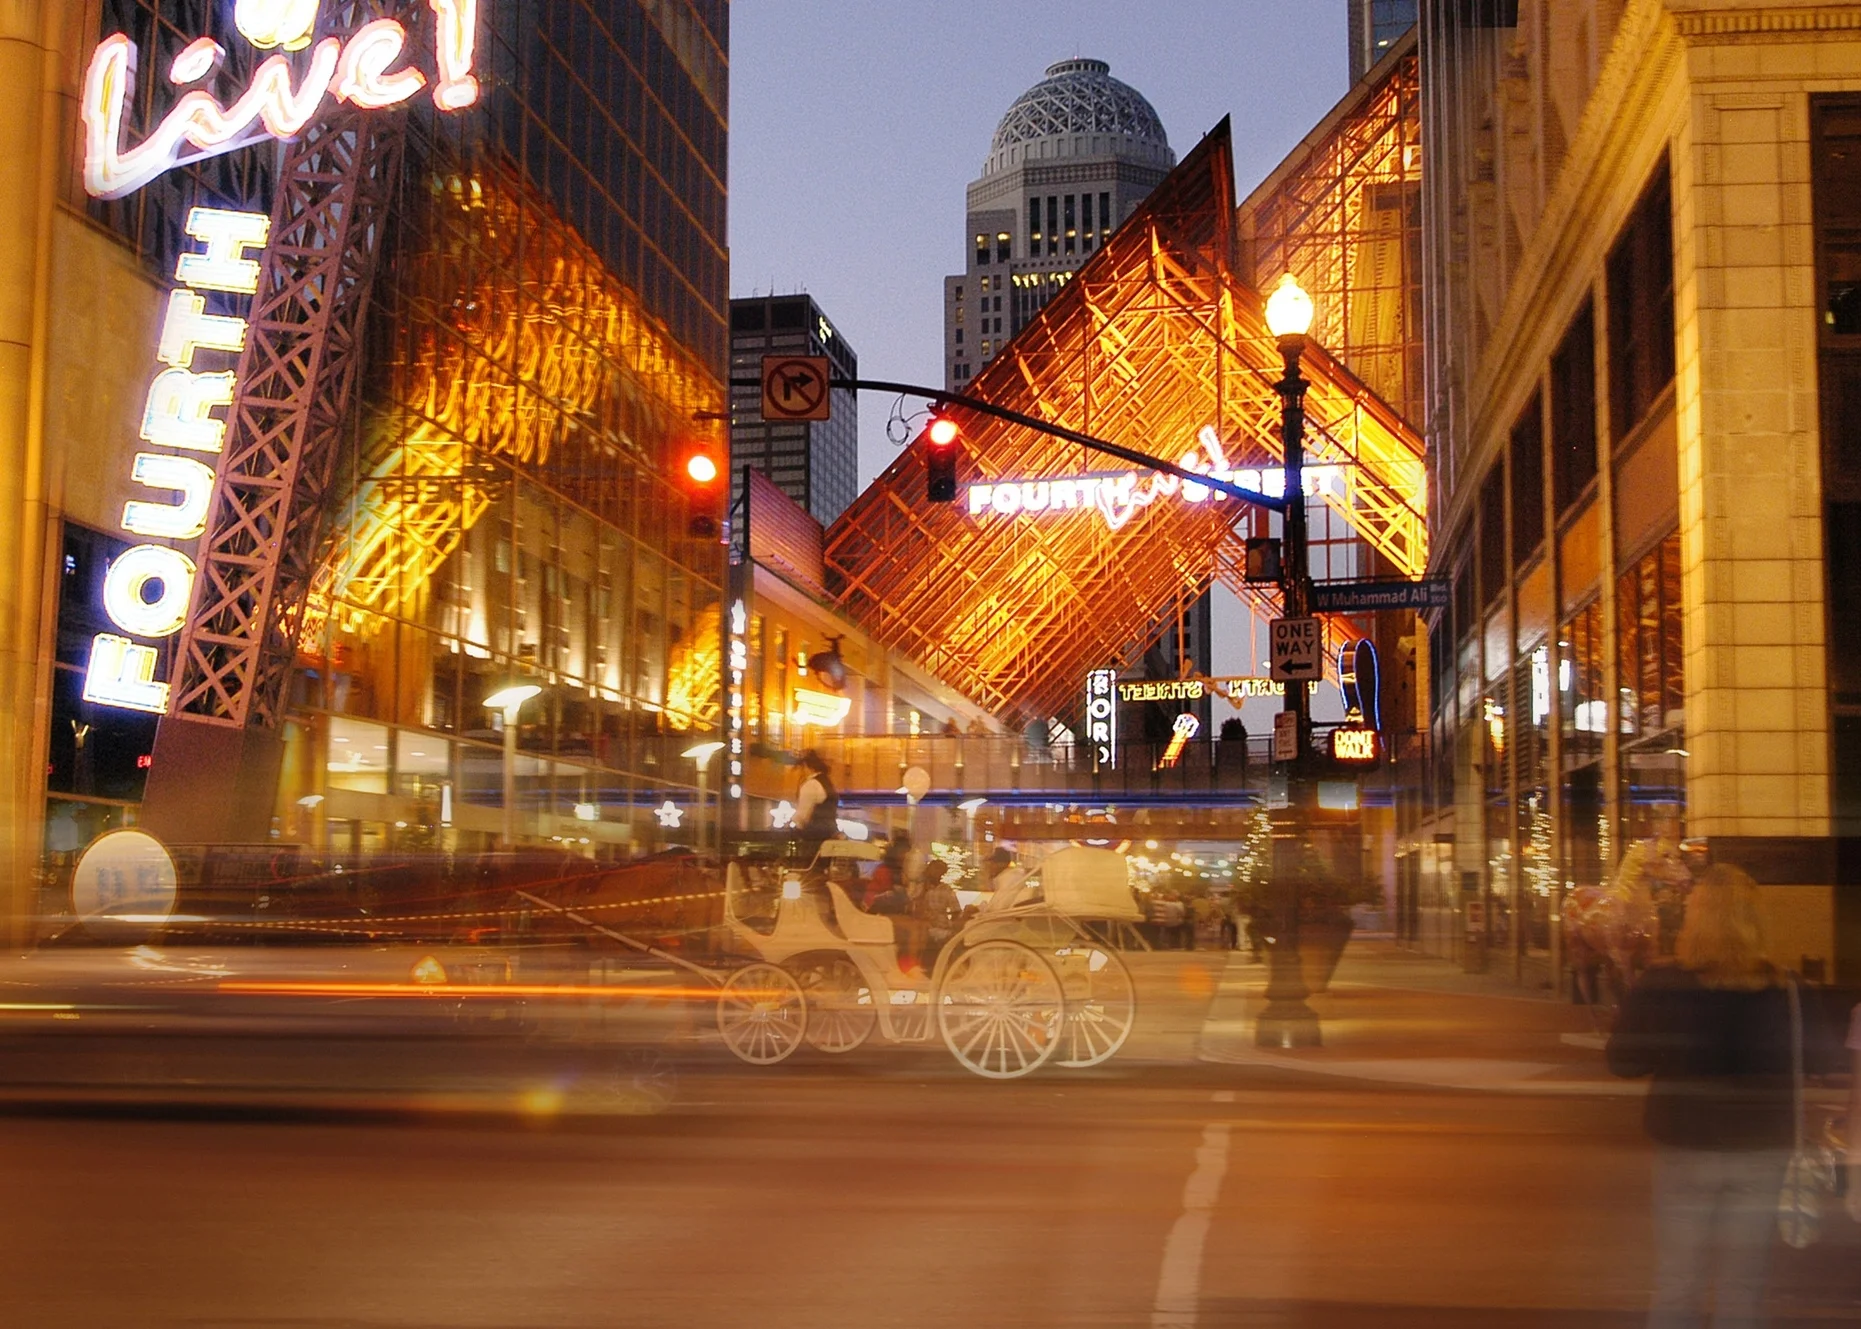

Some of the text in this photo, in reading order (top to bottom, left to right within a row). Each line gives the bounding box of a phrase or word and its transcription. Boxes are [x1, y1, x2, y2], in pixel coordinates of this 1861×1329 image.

[82, 0, 480, 200] Live!
[83, 206, 272, 715] FOURTH
[968, 475, 1133, 515] FOURTH
[1317, 587, 1428, 607] W Muhammad Ali
[1276, 622, 1314, 639] ONE
[1276, 640, 1315, 656] WAY
[1334, 730, 1375, 744] DONT
[1335, 743, 1374, 759] WALK
